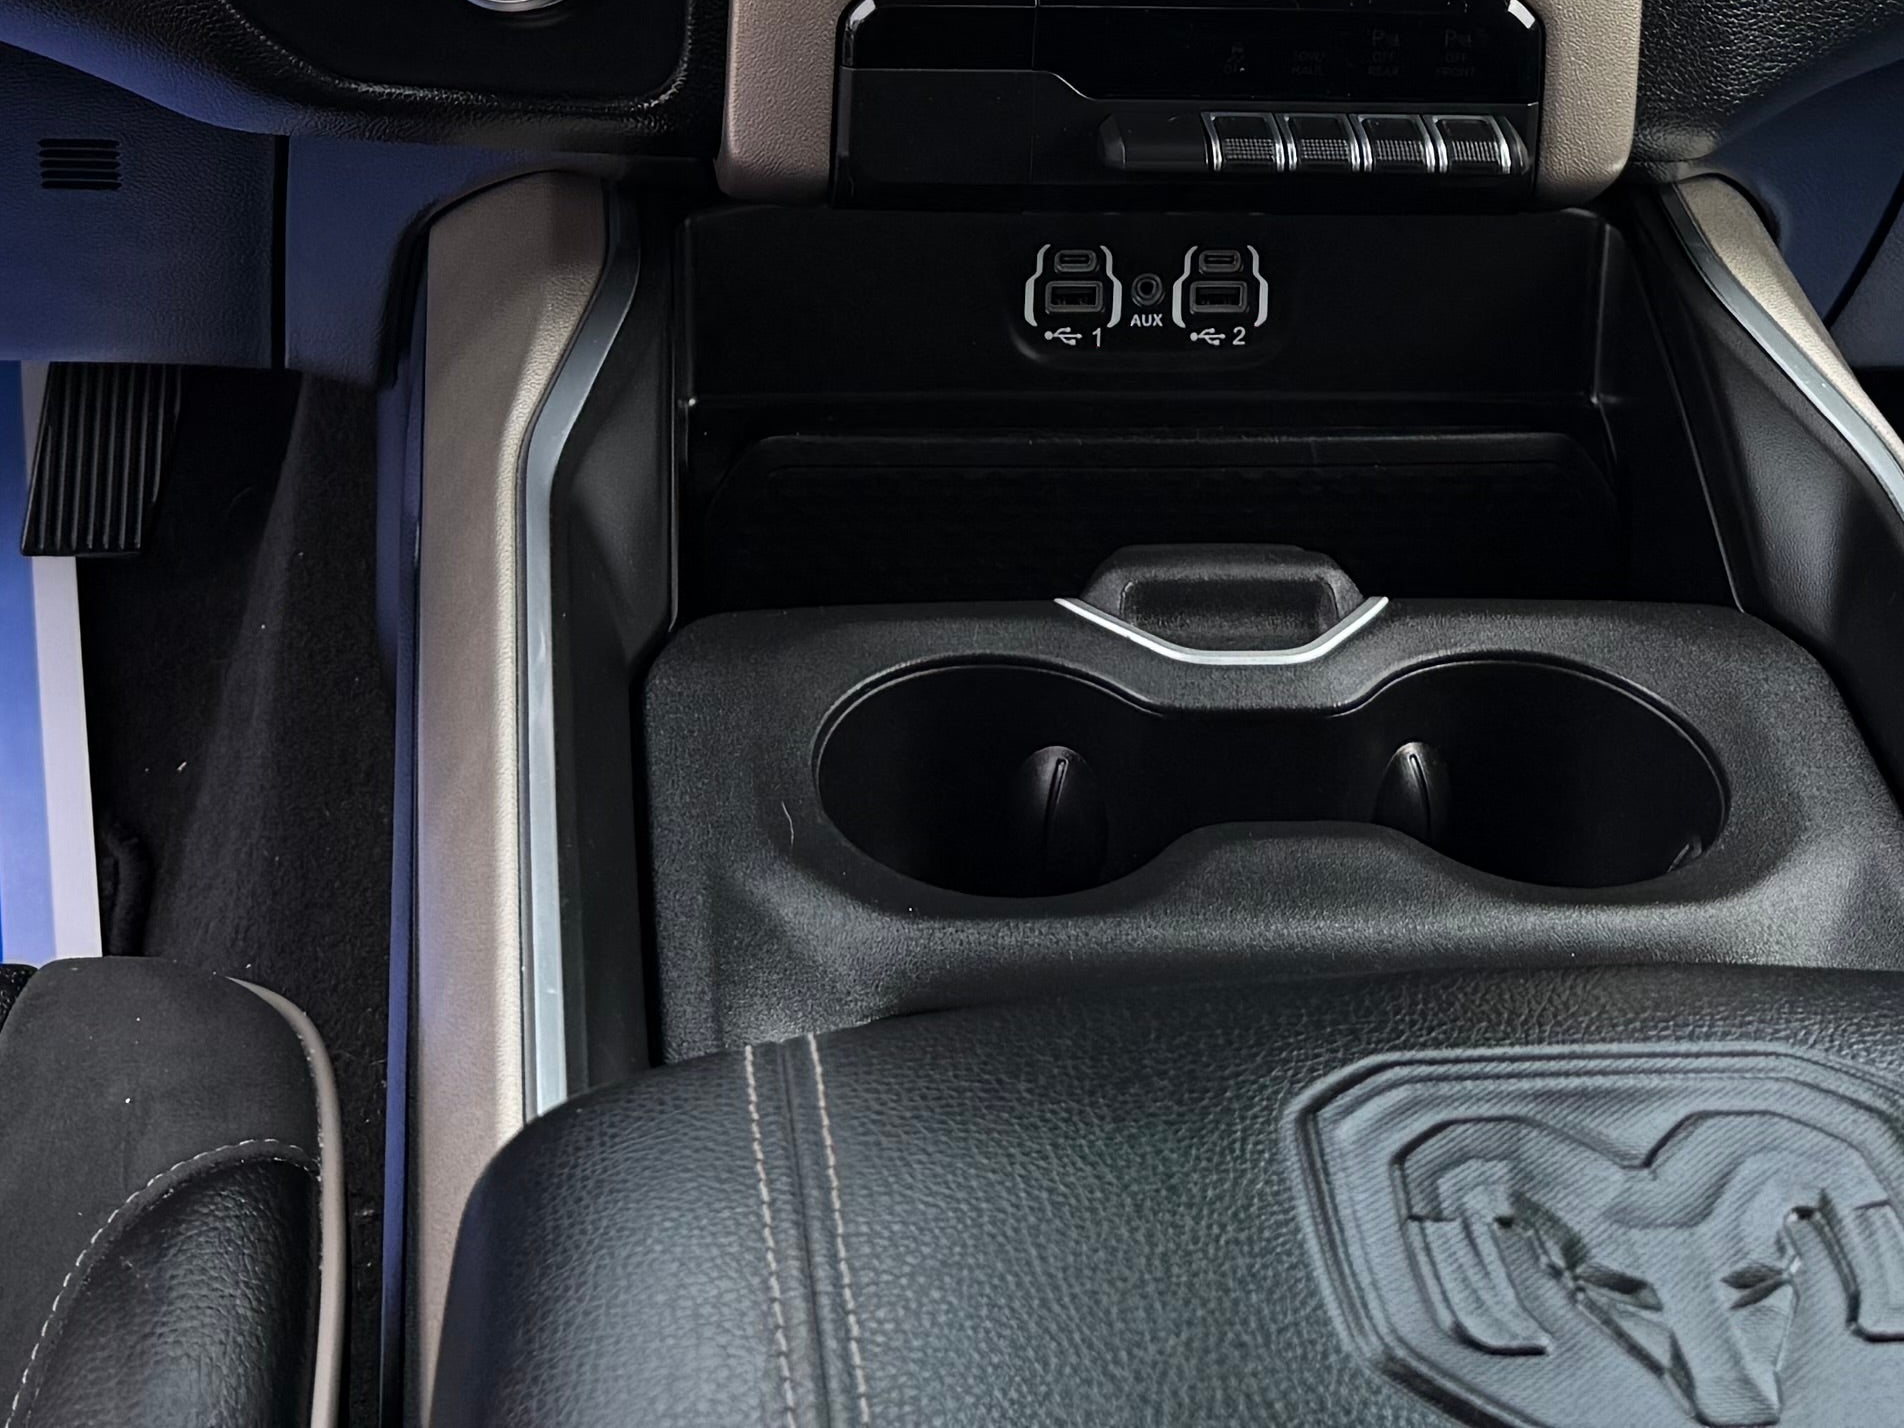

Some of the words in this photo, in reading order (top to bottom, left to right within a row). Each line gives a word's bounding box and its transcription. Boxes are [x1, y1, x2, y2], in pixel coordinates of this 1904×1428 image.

[1129, 313, 1163, 327] AUX
[1092, 327, 1102, 348] 1
[1232, 326, 1246, 346] 2
